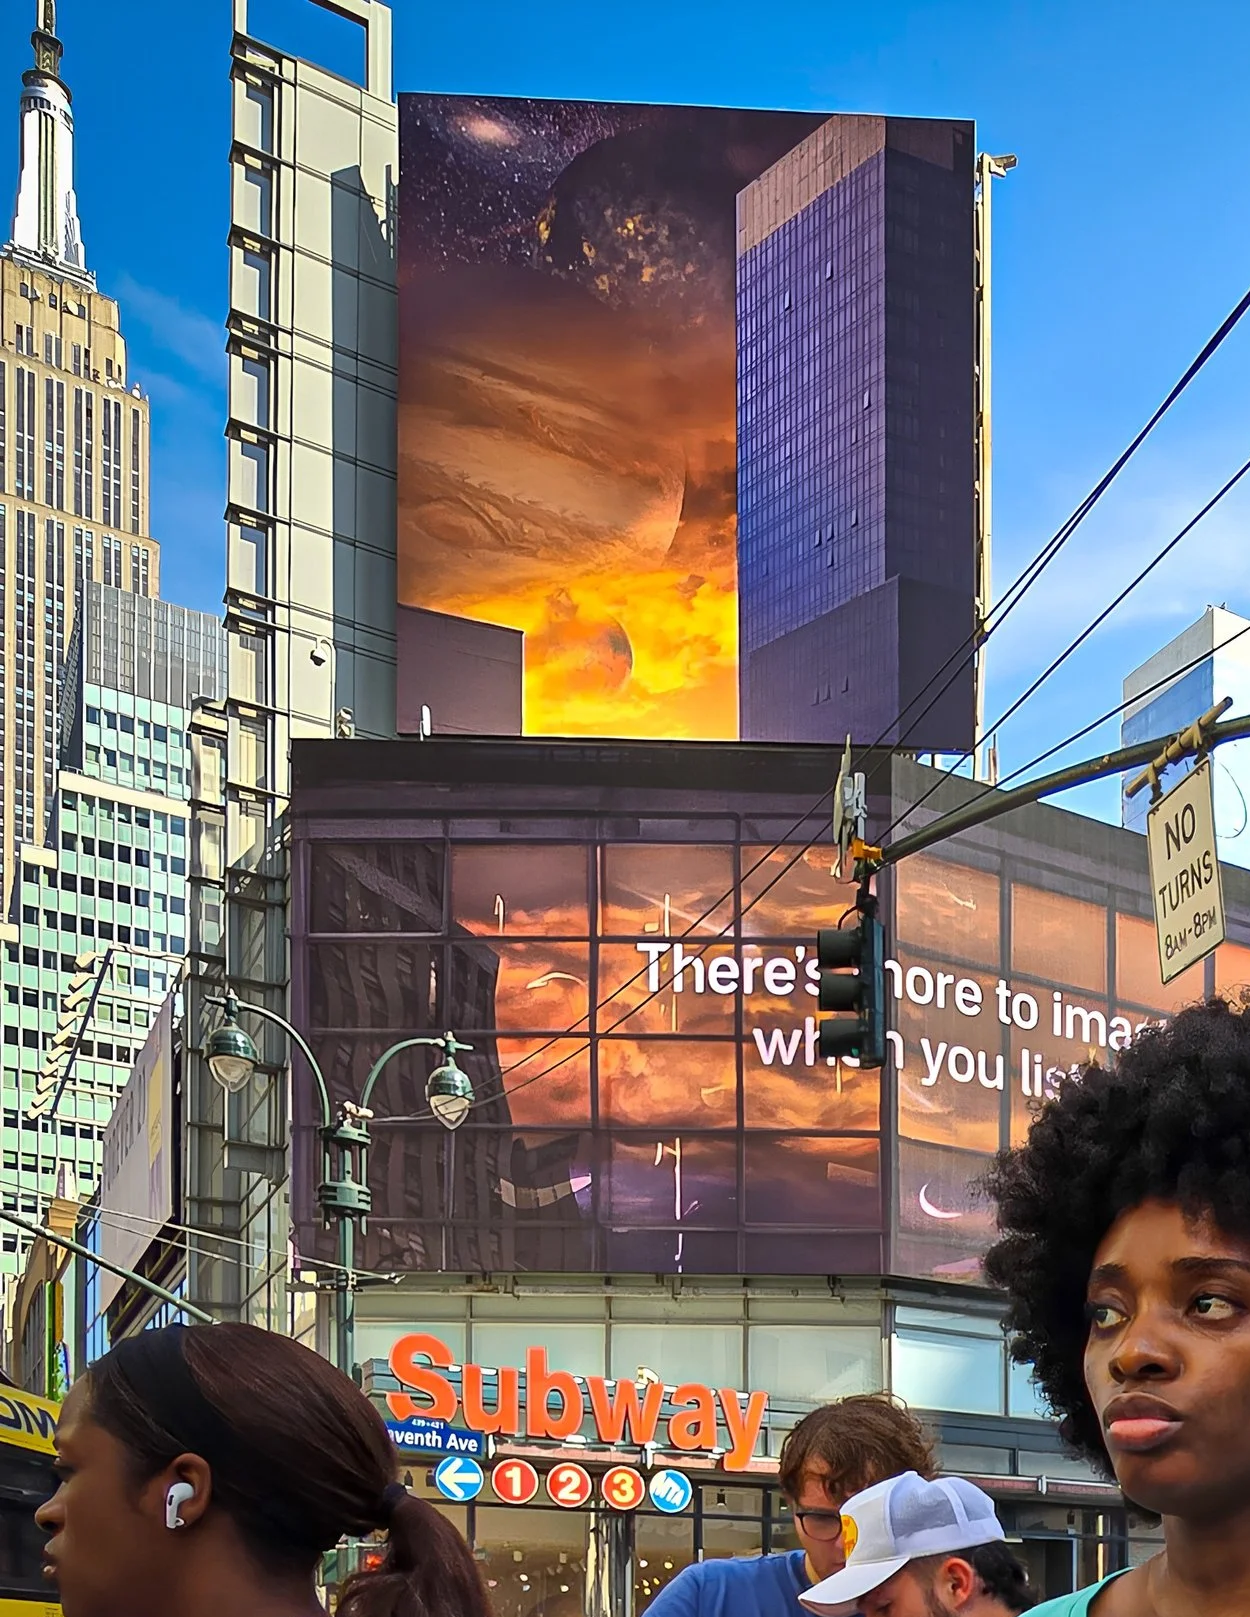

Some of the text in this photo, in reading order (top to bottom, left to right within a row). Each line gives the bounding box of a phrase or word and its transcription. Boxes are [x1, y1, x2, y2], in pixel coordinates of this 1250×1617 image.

[1163, 802, 1196, 860] NO
[1158, 849, 1214, 919] TURNS
[1164, 905, 1217, 961] 8AM-8PM
[636, 941, 822, 997] There's
[995, 979, 1040, 1031] to
[1052, 990, 1153, 1051] ima
[920, 1036, 1004, 1092] you
[385, 1331, 770, 1472] Subway
[387, 1429, 479, 1453] venth Ave
[504, 1466, 635, 1505] 1 2 3
